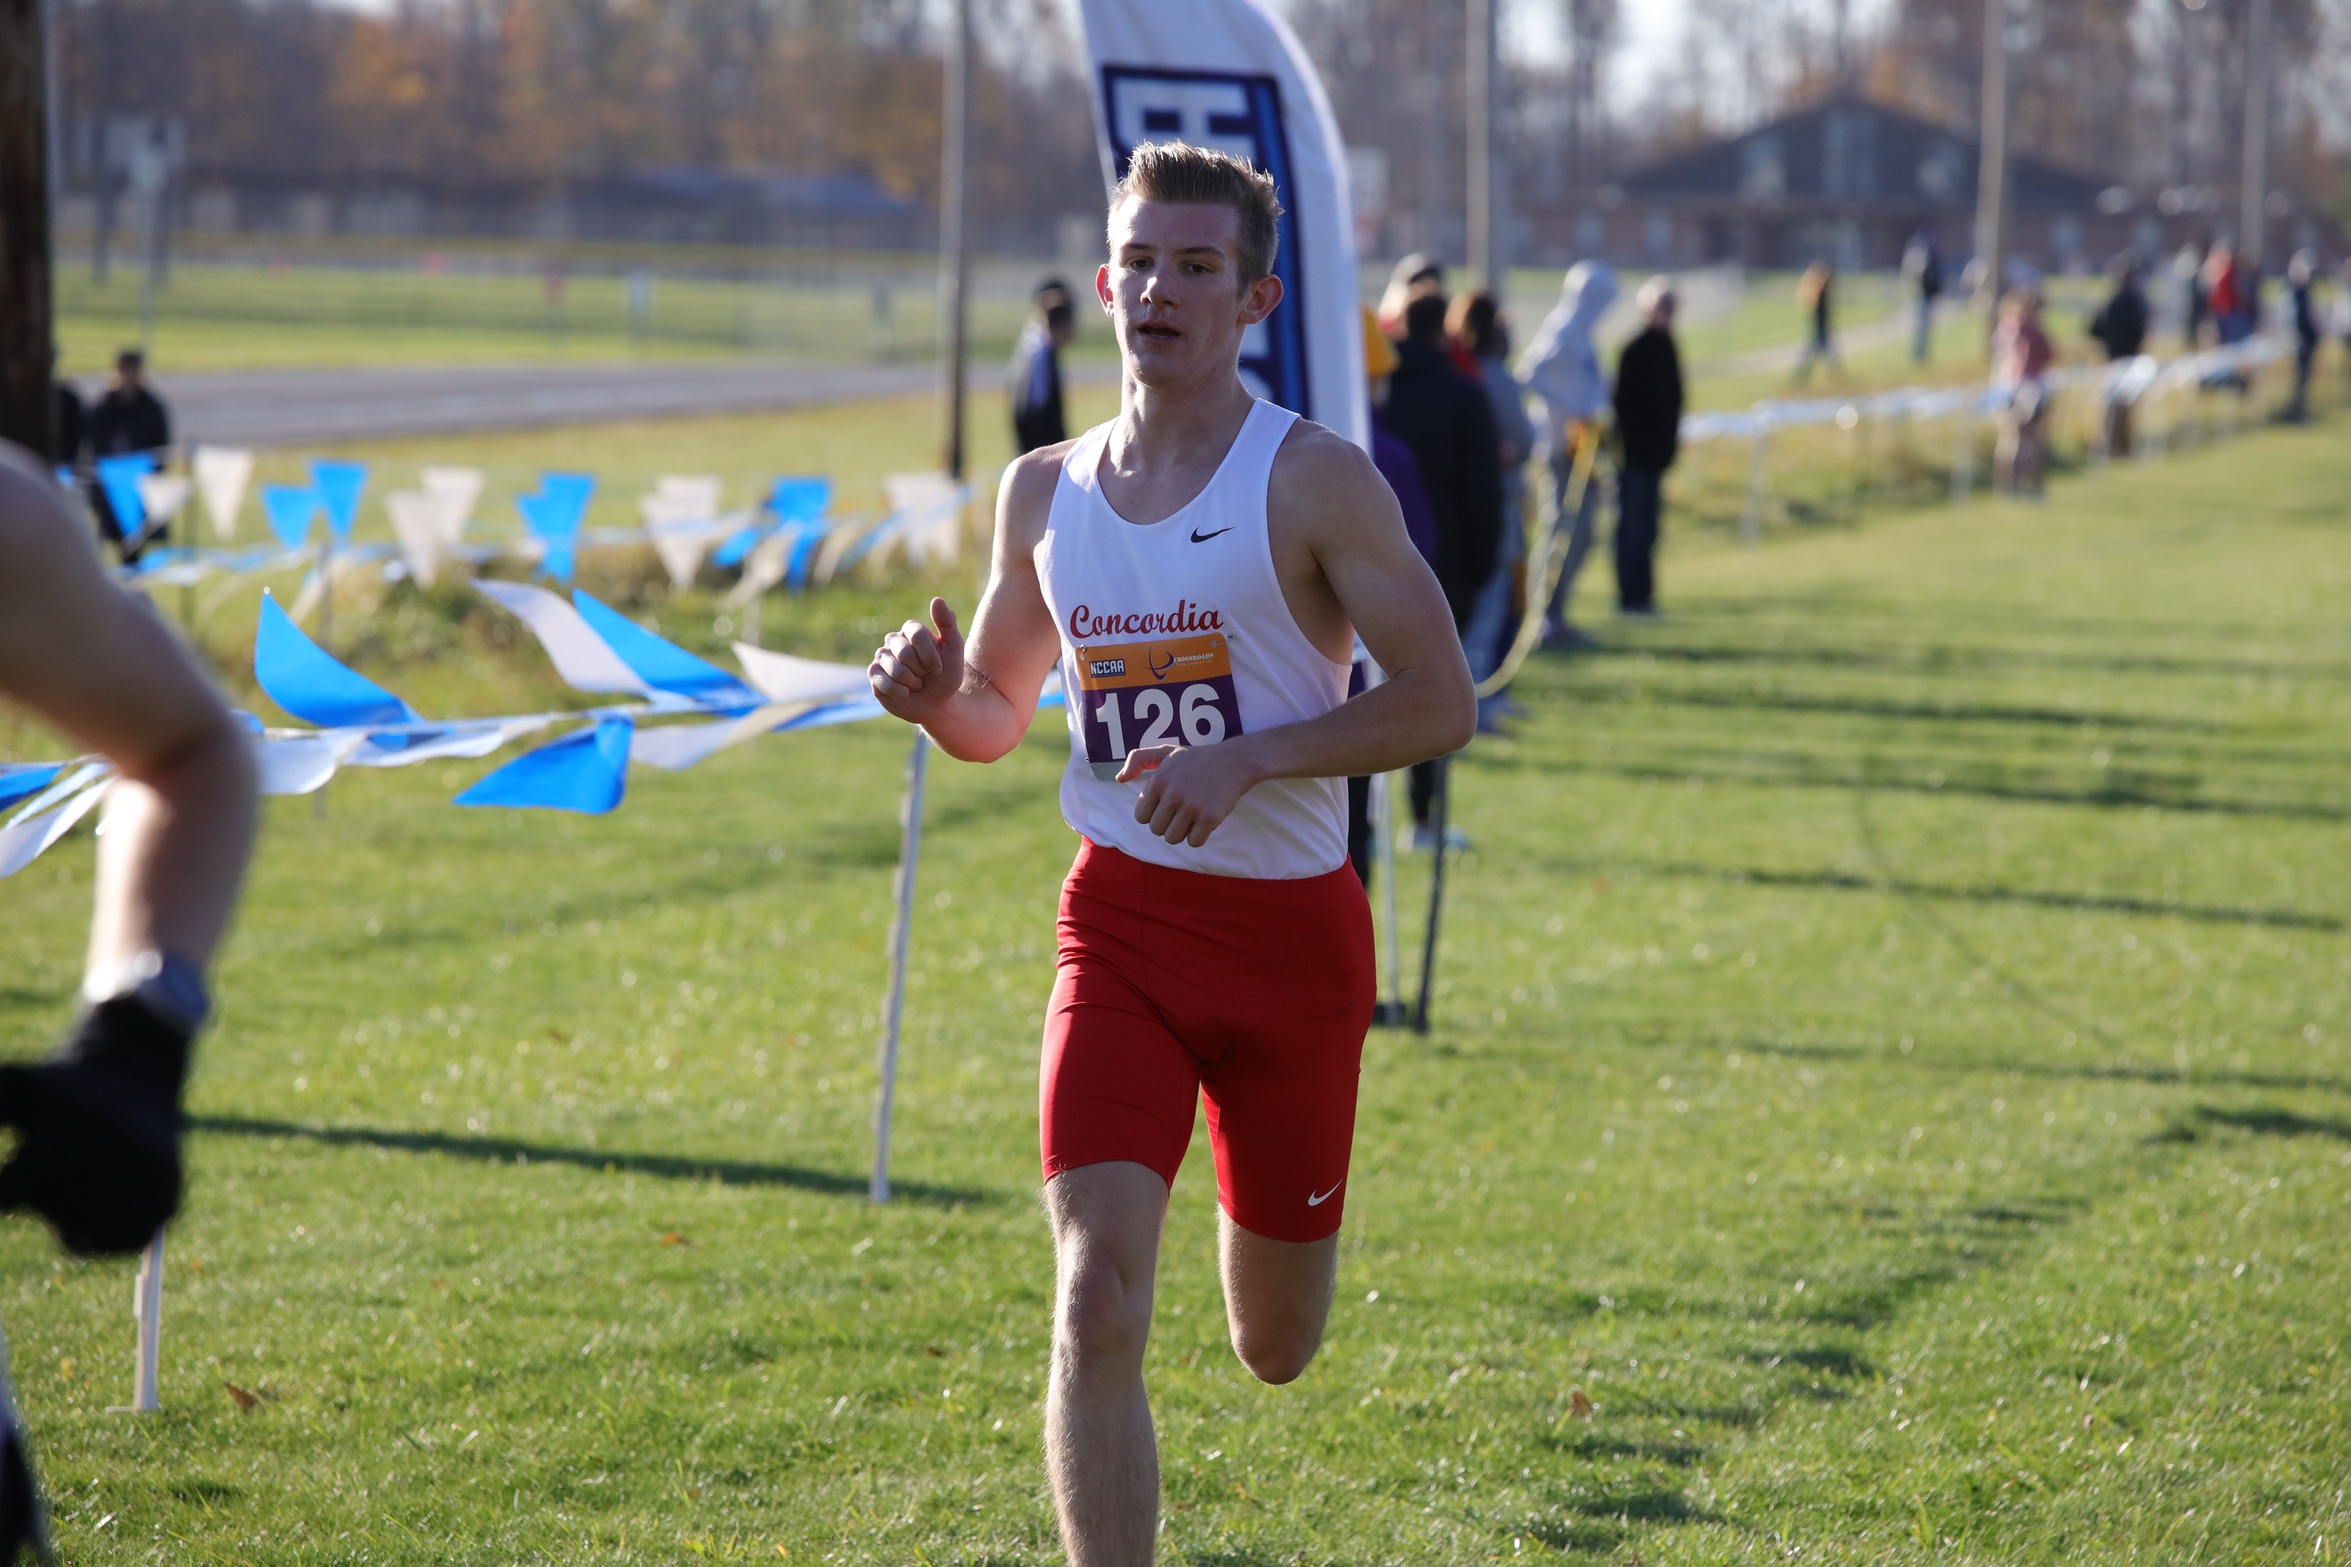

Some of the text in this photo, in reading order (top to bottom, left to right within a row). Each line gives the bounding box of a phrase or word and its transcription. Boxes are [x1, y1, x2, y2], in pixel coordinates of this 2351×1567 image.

[1070, 599, 1224, 639] Concordia
[1090, 660, 1125, 675] NCCAA
[1174, 652, 1214, 663] CROSSROADS
[1096, 683, 1226, 760] 126
